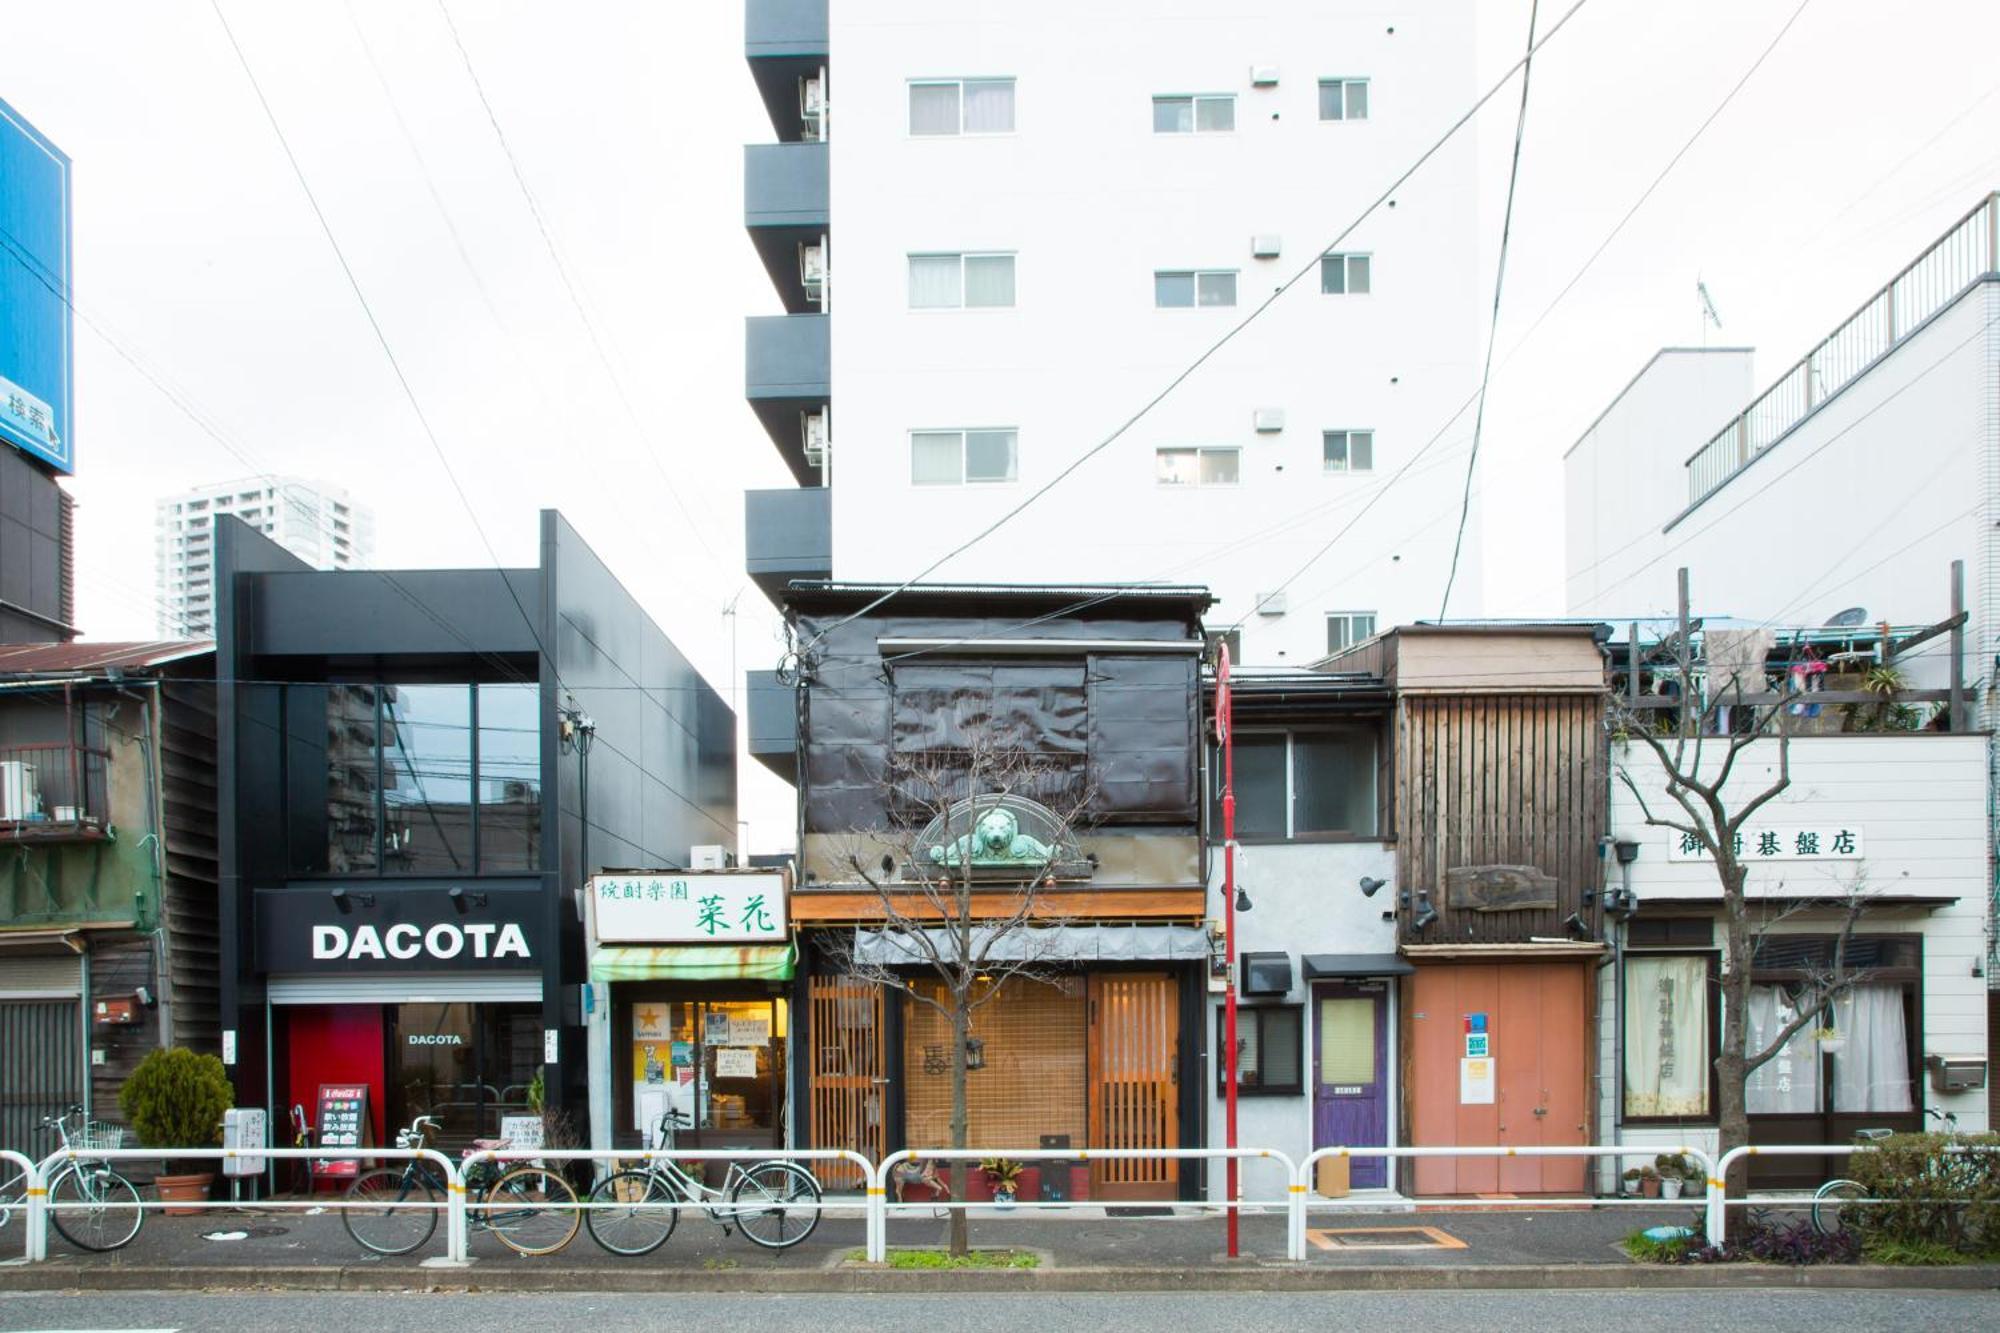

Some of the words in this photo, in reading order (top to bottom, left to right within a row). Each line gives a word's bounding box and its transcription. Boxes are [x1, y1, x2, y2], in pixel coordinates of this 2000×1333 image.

[9, 394, 45, 431] 検索
[696, 894, 775, 935] 菜花
[312, 923, 531, 960] DACOTA
[409, 1034, 462, 1045] DACOTA
